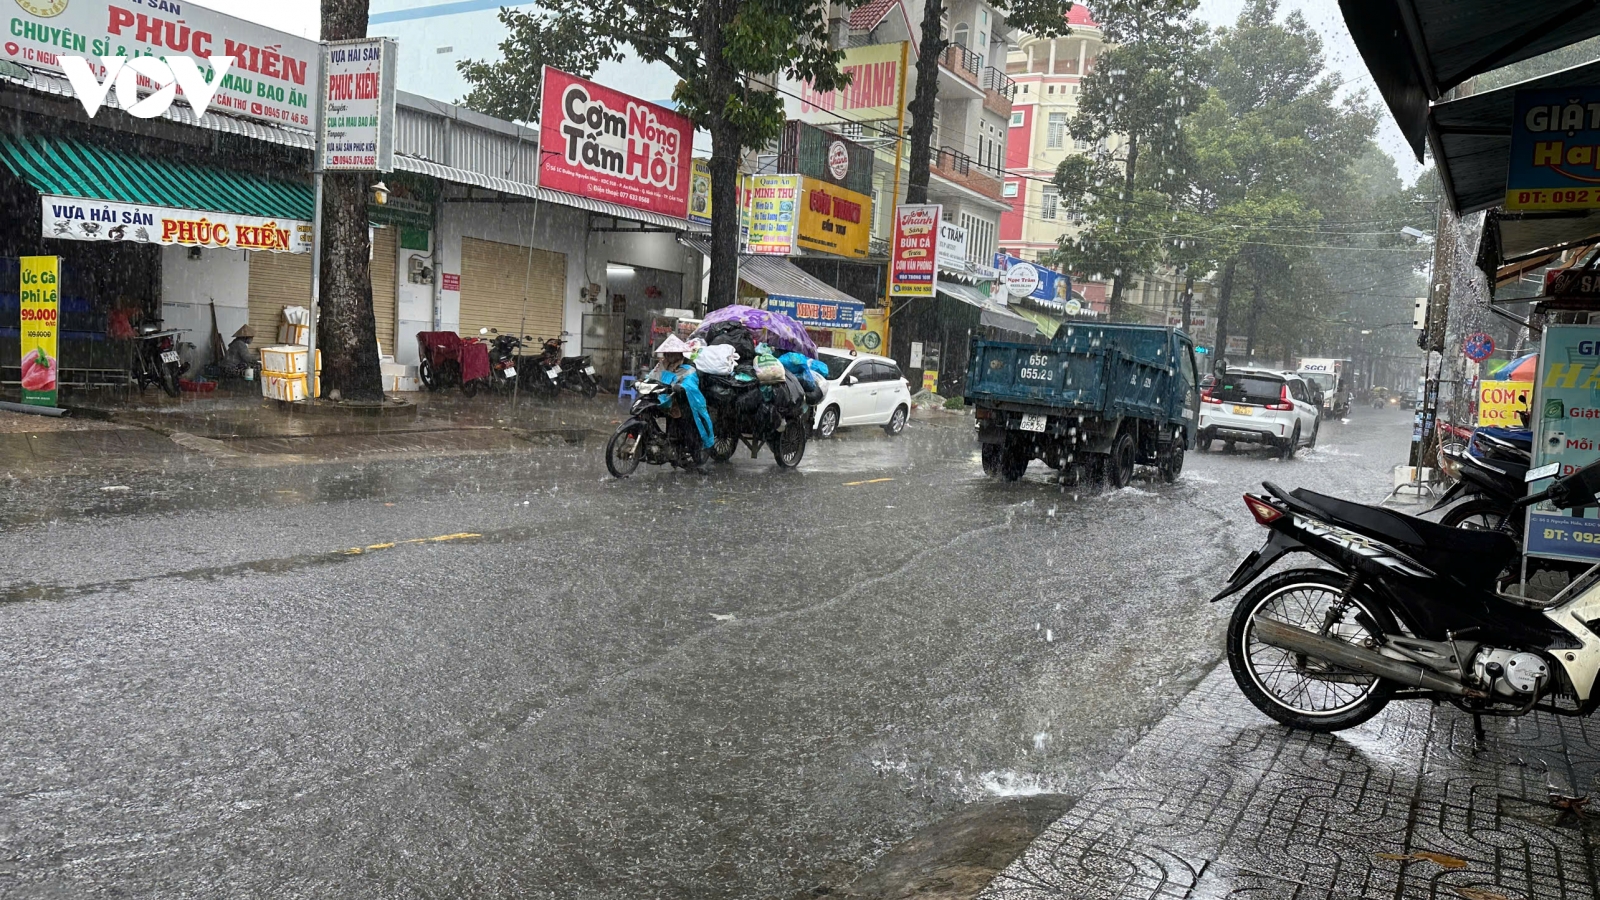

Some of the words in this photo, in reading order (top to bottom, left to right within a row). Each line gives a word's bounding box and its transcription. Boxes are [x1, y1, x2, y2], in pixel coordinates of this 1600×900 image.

[10, 18, 86, 53] CHUYÊN
[22, 47, 34, 60] 1C
[107, 5, 212, 59] PHÚC
[225, 39, 307, 86] KIẾN
[347, 44, 360, 62] HẢI
[363, 43, 380, 61] SẢN
[328, 68, 353, 101] PHÚC
[355, 62, 379, 100] KIẾN
[842, 61, 896, 110] THANH
[219, 74, 253, 94] MAU
[257, 82, 285, 103] BAO
[288, 87, 308, 108] ĂN
[233, 98, 247, 111] THƠ
[264, 106, 280, 119] 0945
[281, 111, 289, 120] 07
[290, 112, 299, 123] 46
[300, 115, 309, 125] 56
[327, 117, 337, 128] CUA
[338, 116, 345, 127] CÀ
[345, 117, 357, 127] MAU
[358, 116, 368, 127] BAO
[369, 115, 378, 127] ĂN
[565, 88, 627, 140] Cơm
[628, 106, 678, 155] Nóng
[563, 124, 624, 175] Tấm
[754, 188, 775, 199] MINH
[778, 186, 795, 199] THƯ
[1518, 191, 1547, 204] ĐT:
[1552, 190, 1589, 203] 092
[90, 205, 118, 223] HẢI
[122, 208, 154, 226] SẢN
[901, 214, 933, 226] Thanh
[161, 217, 230, 246] PHÚC
[235, 221, 292, 251] KIẾN
[900, 236, 917, 248] BÚN
[919, 235, 931, 248] CÁ
[22, 268, 38, 285] Ức
[40, 270, 56, 284] Gà
[21, 289, 40, 303] Phi
[43, 289, 57, 303] Lê
[21, 308, 57, 321] 99.000
[796, 302, 820, 319] MINH
[820, 303, 839, 320] THƯ
[1029, 354, 1048, 367] 65C
[1565, 438, 1593, 451] Mỗi
[1543, 528, 1569, 541] ĐT:
